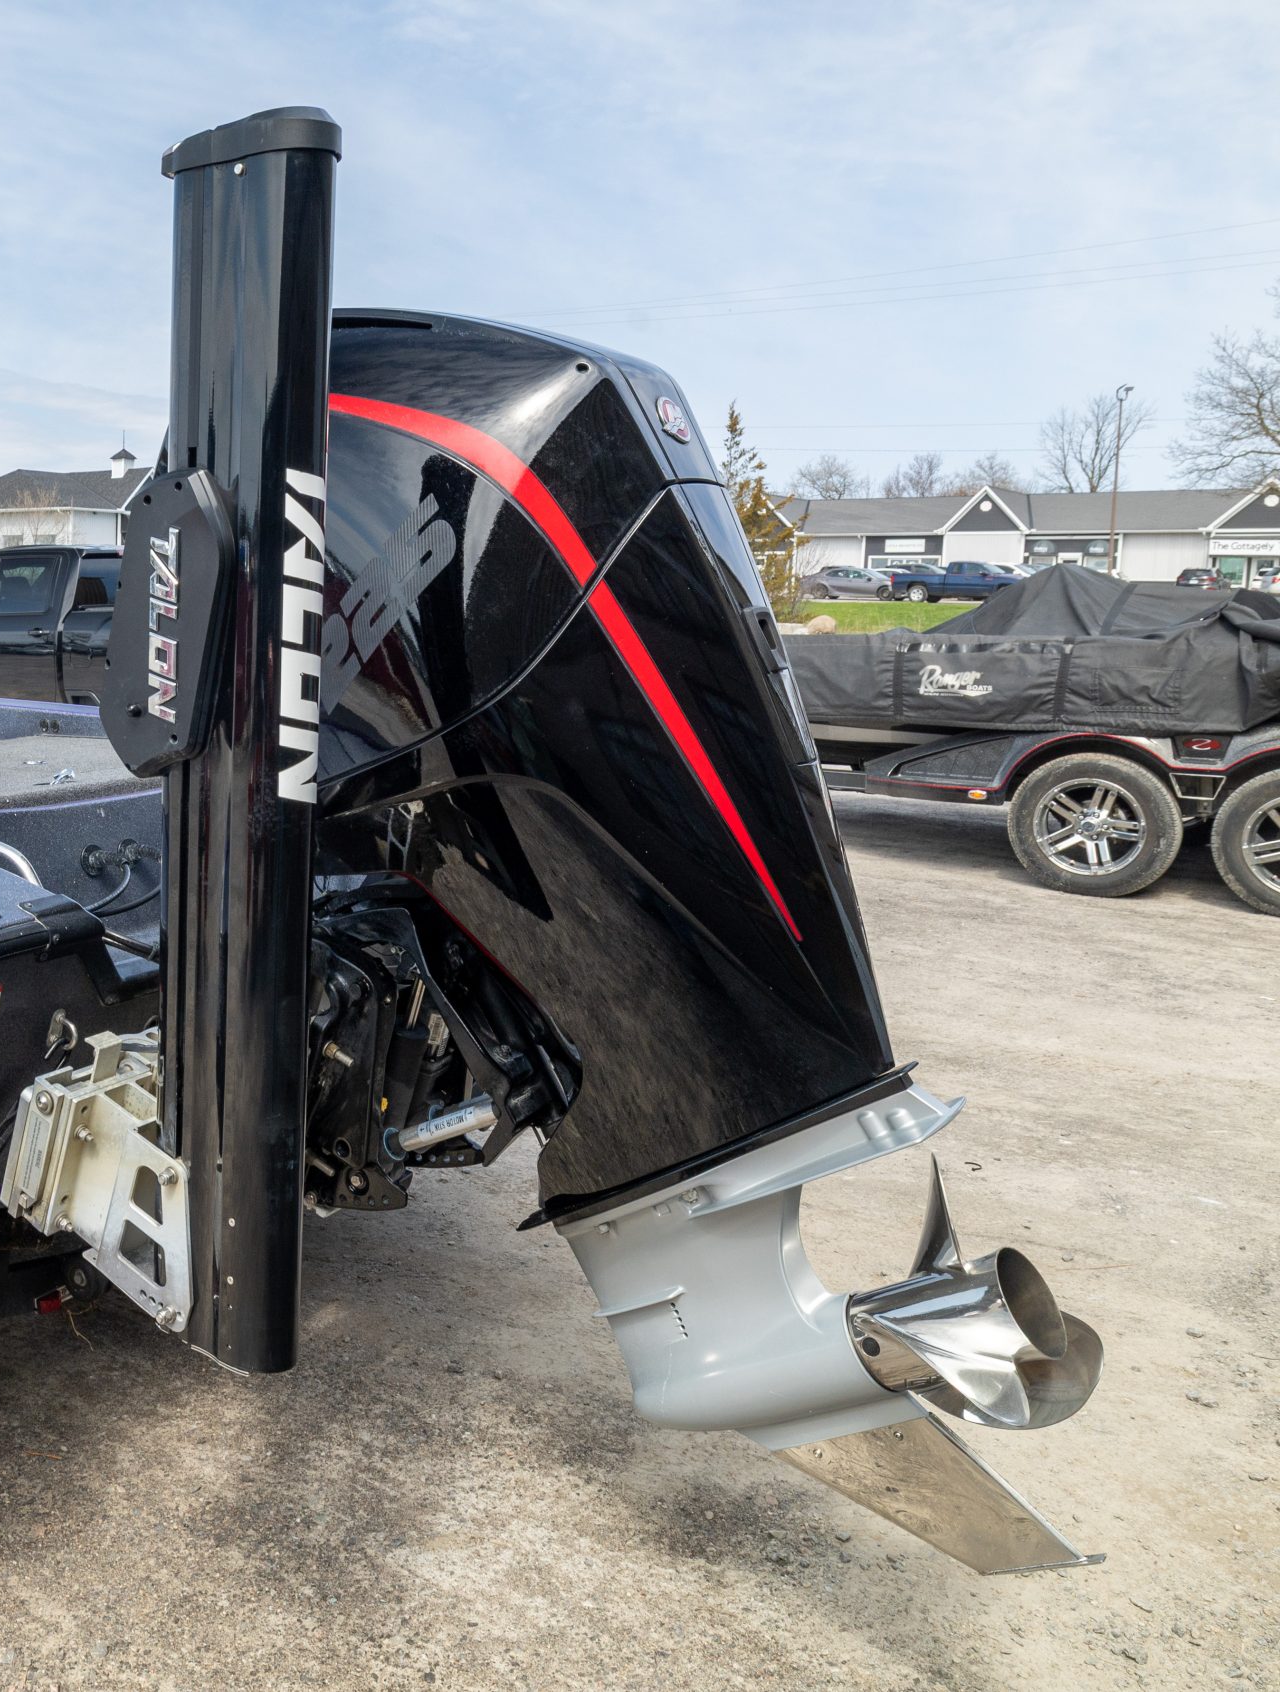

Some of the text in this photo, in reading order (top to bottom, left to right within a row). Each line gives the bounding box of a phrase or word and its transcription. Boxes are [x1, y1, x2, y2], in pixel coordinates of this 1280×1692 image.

[1212, 541, 1274, 551] The Cottagely
[147, 526, 179, 724] TALON
[277, 468, 326, 804] TALON
[919, 664, 983, 695] Ranger
